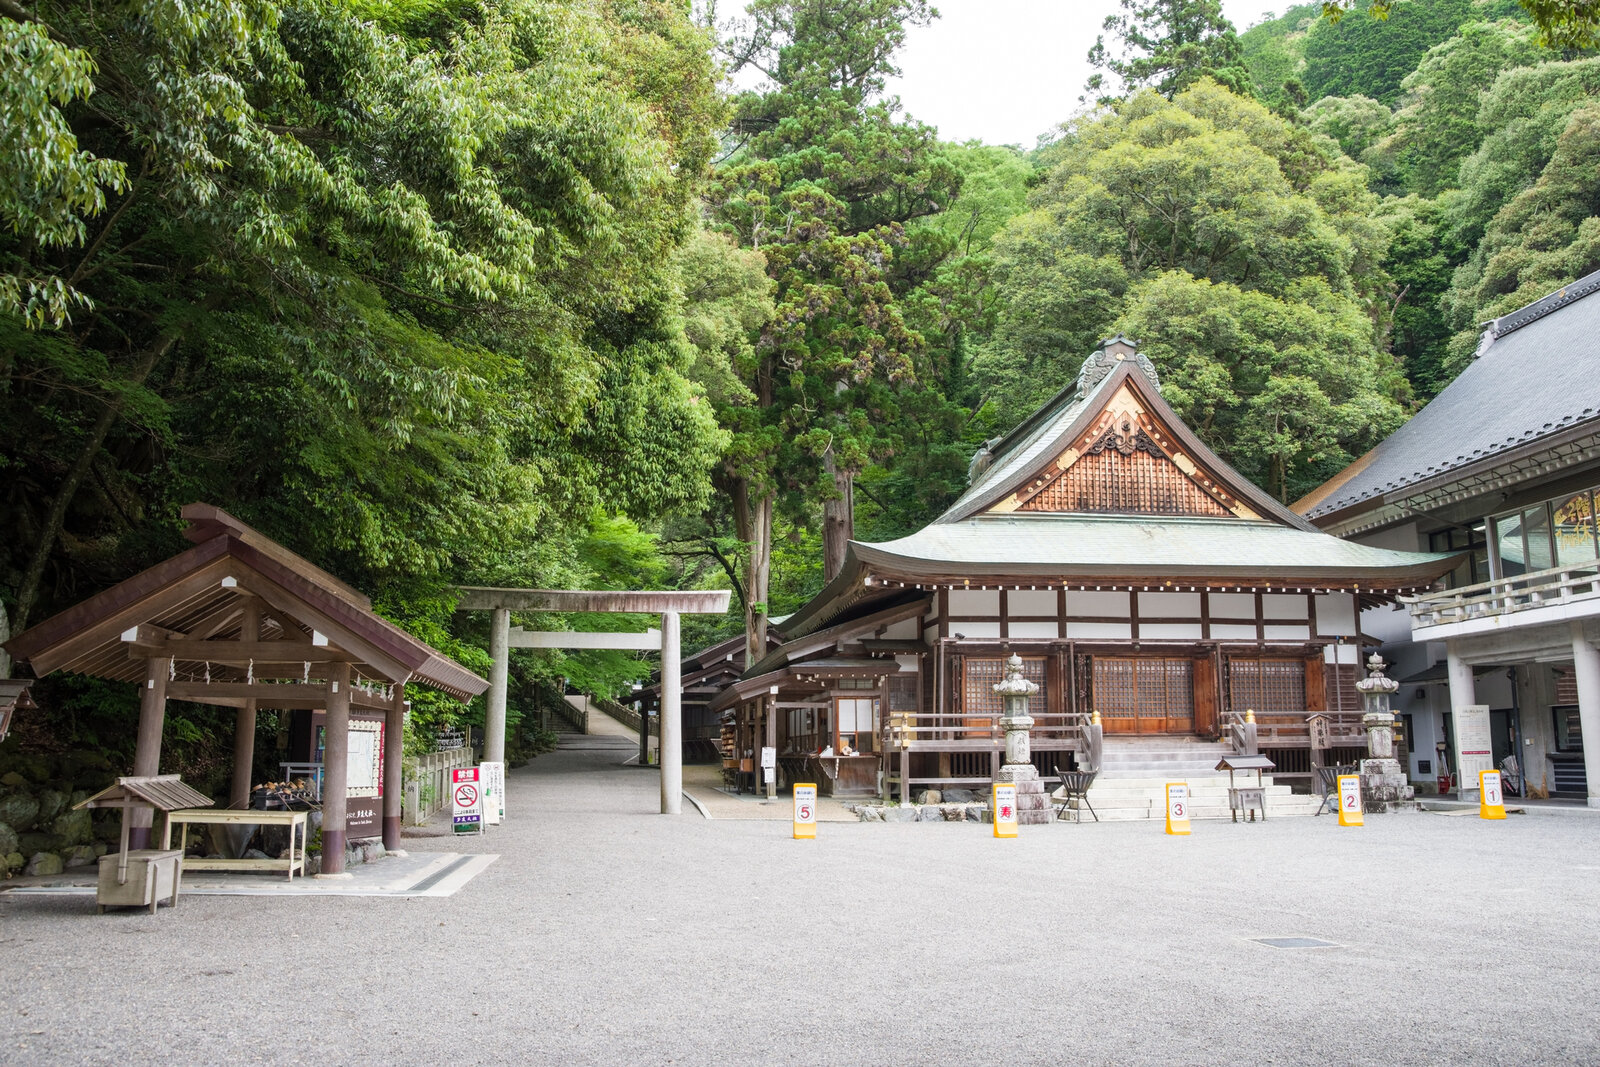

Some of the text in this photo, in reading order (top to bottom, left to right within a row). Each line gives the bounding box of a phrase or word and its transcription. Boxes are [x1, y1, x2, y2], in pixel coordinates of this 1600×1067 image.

[1346, 795, 1356, 808] 2
[1489, 790, 1496, 802] 1
[800, 806, 810, 819] 5
[1000, 805, 1013, 819] 寿
[1174, 803, 1184, 817] 3
